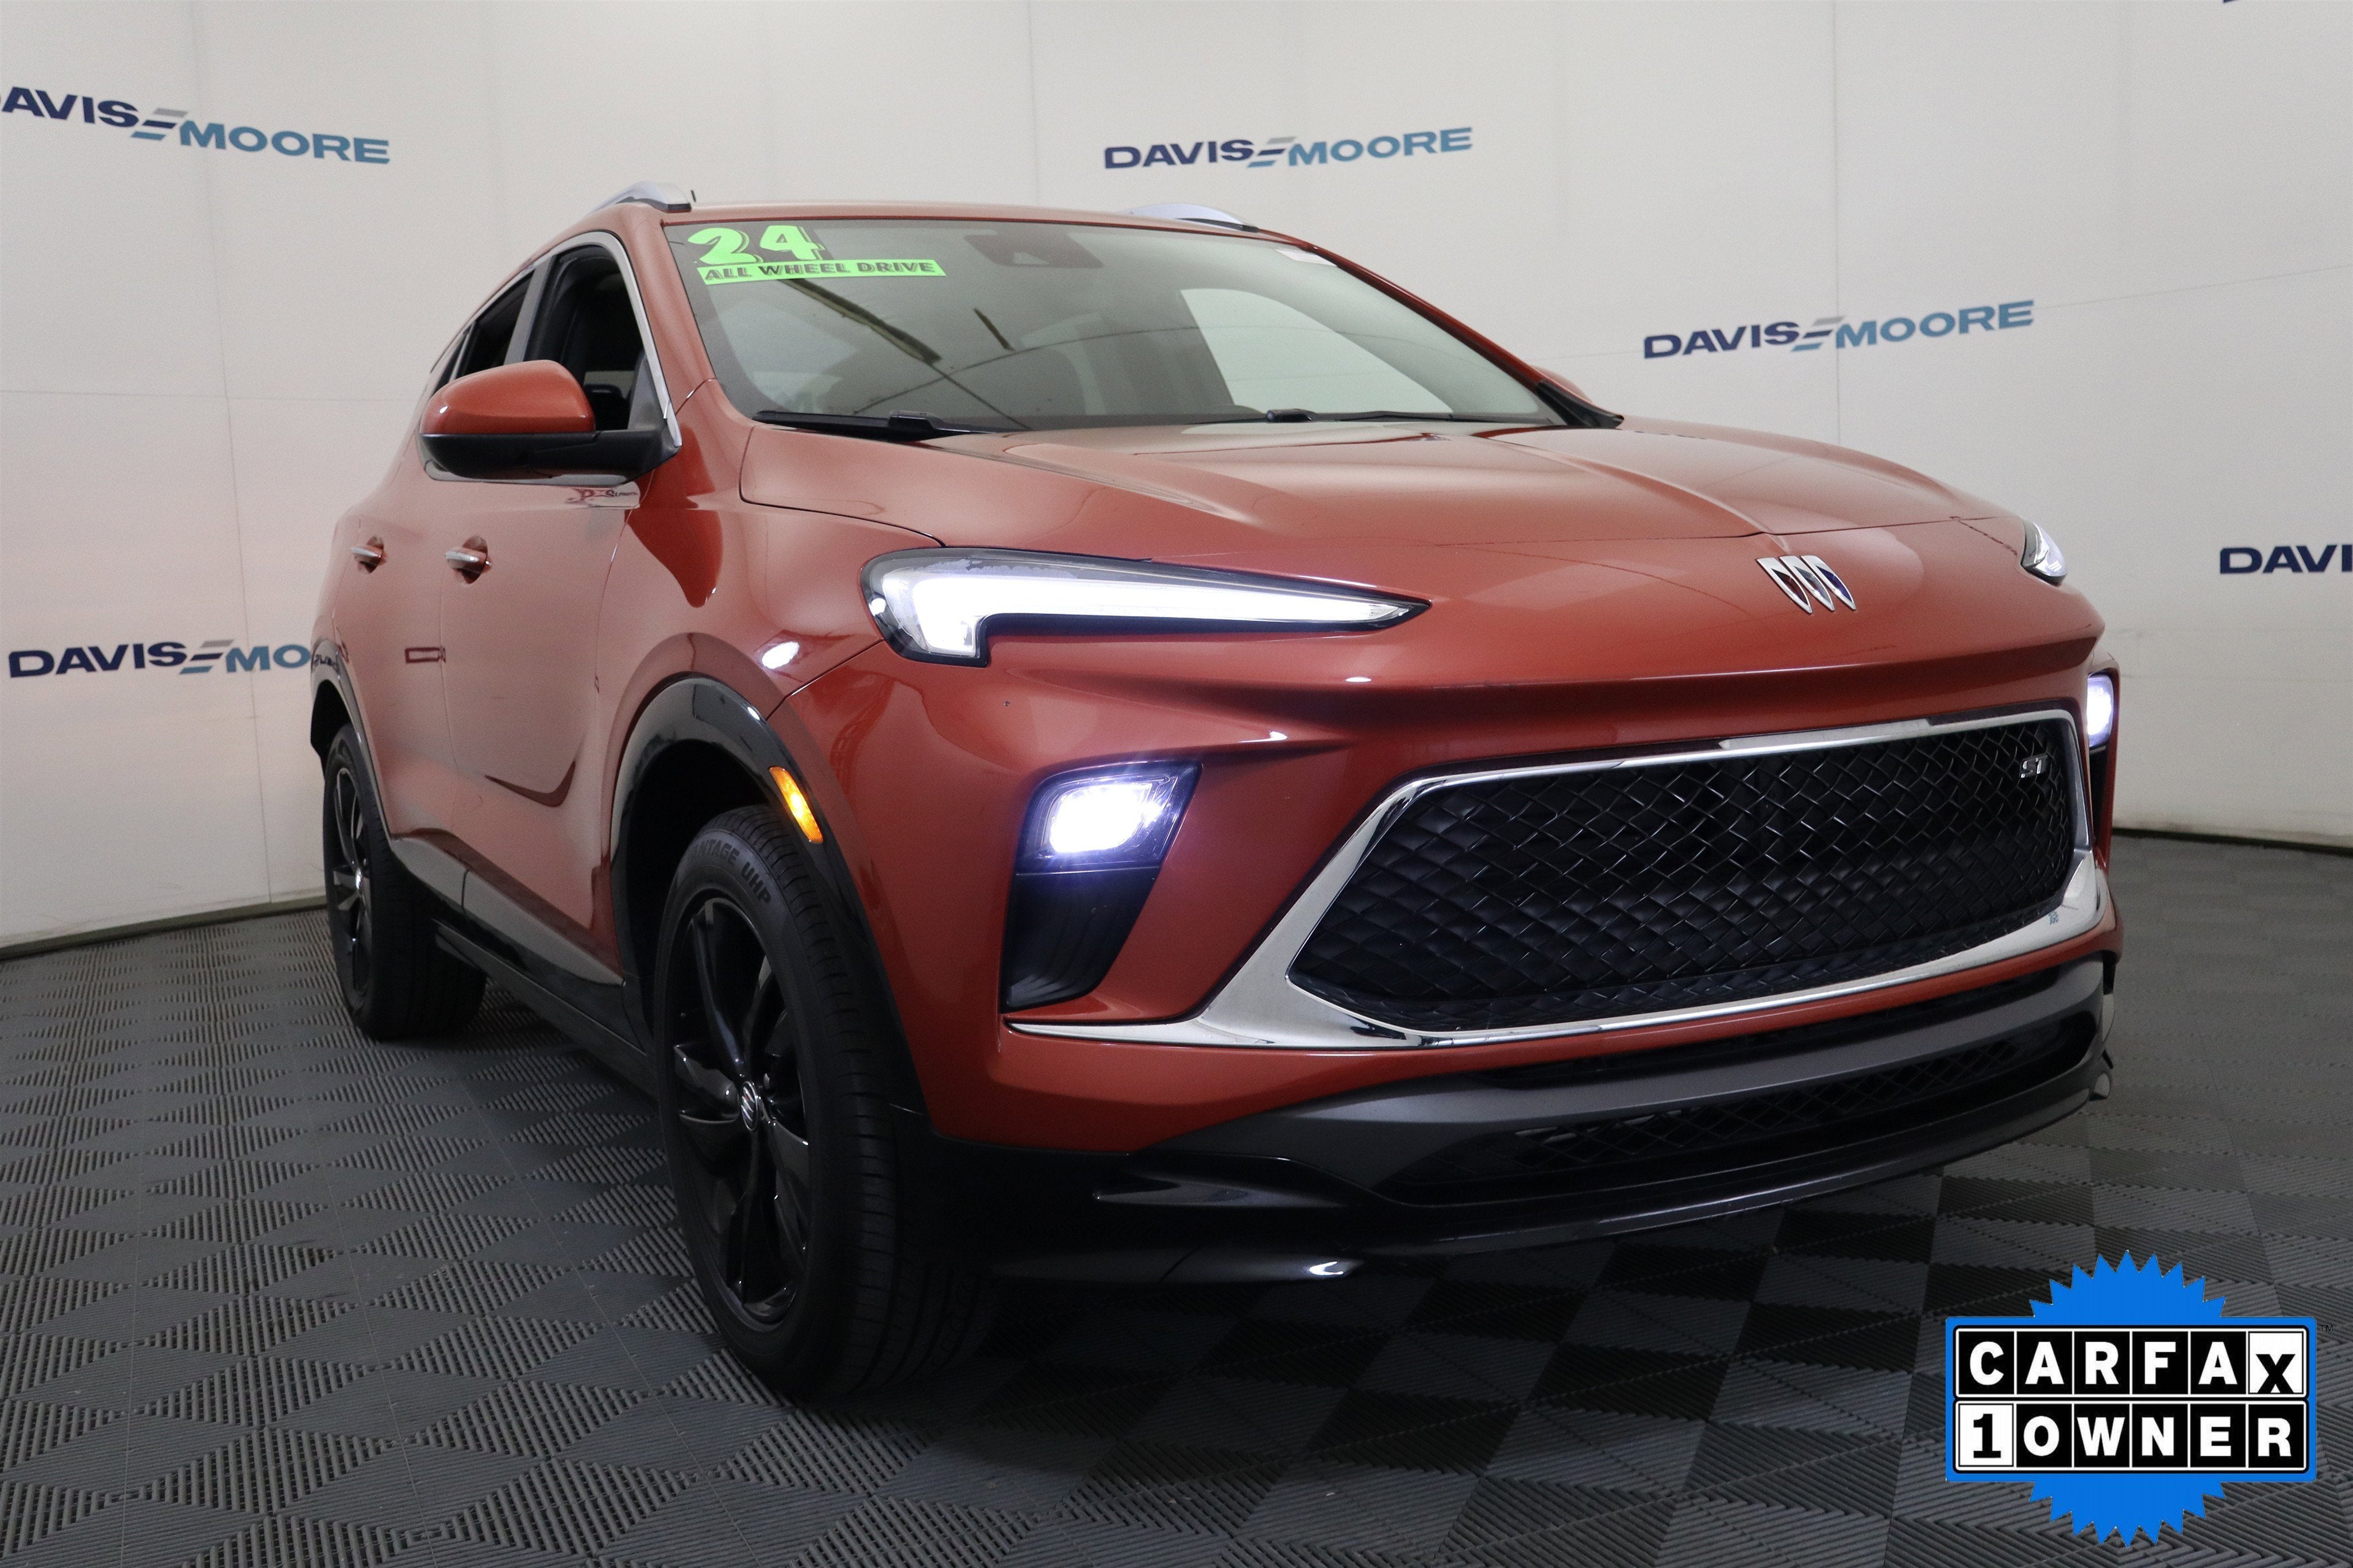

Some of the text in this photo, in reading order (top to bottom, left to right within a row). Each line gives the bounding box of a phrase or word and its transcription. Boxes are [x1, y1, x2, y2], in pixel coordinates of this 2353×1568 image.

[0, 86, 390, 164] AVIS MOORE
[1104, 127, 1472, 168] DAVIS MOORE
[688, 225, 826, 265] 24
[705, 261, 936, 281] ALL WHEEL DRIVE
[1644, 300, 2034, 359] DAVIS MOORE
[2220, 543, 2353, 574] DAVI
[8, 642, 188, 678] DAVIS
[225, 644, 311, 674] MO
